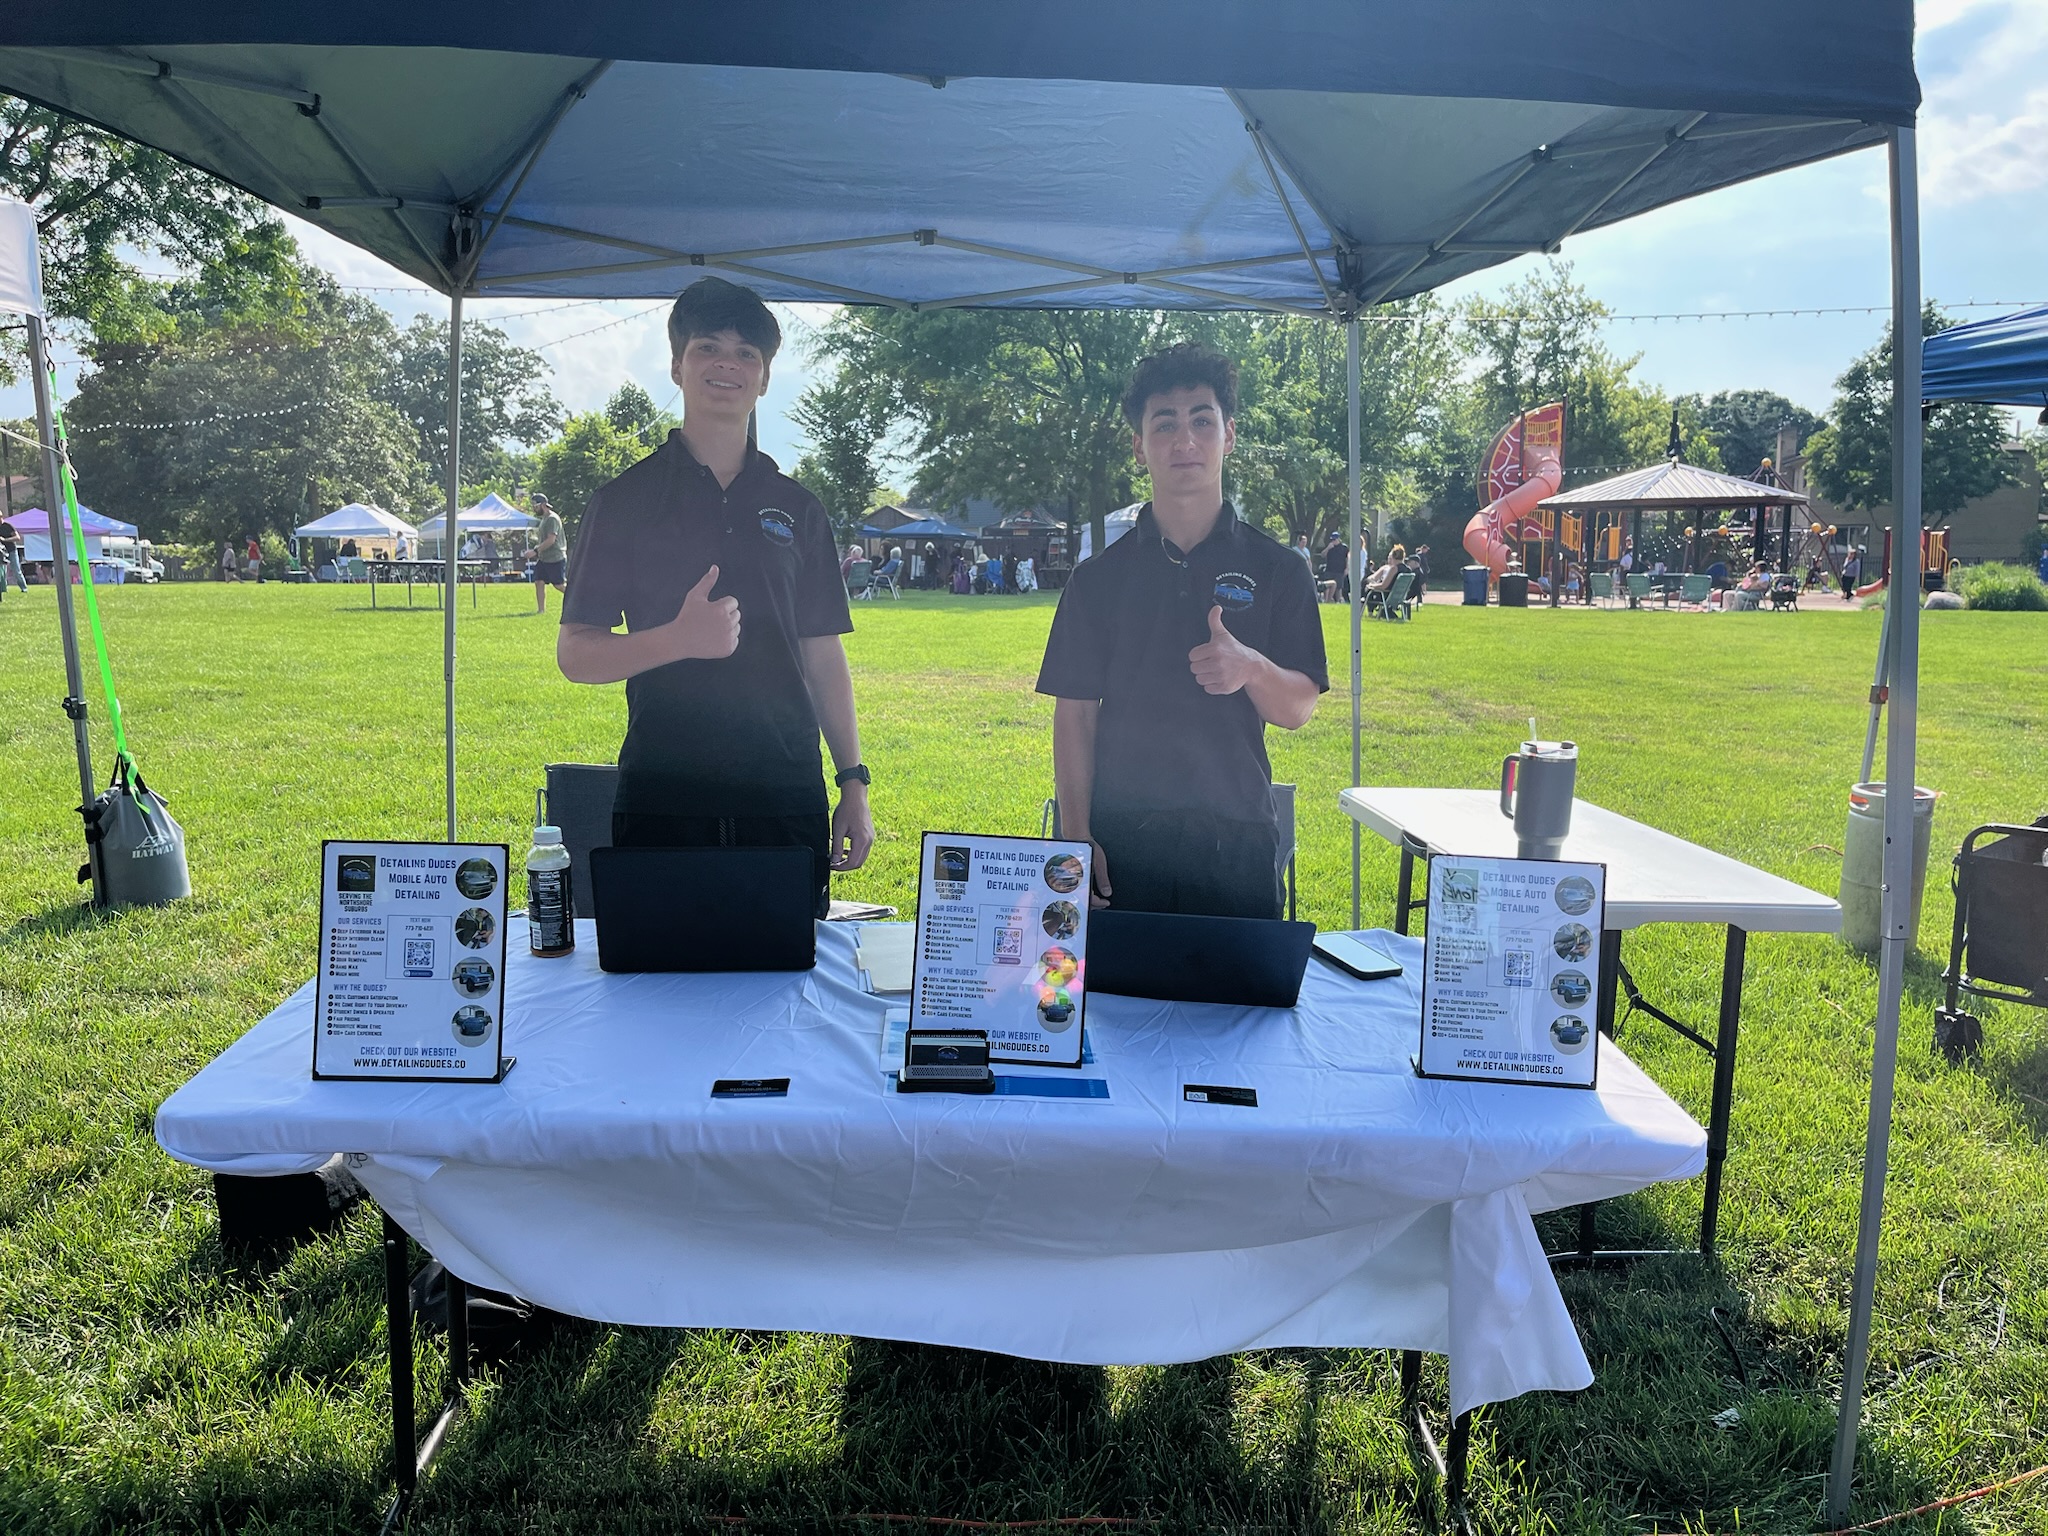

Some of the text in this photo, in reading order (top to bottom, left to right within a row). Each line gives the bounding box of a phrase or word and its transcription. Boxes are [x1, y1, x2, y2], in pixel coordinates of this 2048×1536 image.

[1216, 572, 1242, 581] DETAILING
[132, 843, 174, 858] HATWAY
[974, 850, 1017, 862] DETAILING
[1018, 852, 1045, 863] DUDES
[381, 858, 426, 868] DETAILING
[428, 859, 457, 869] DUDES
[981, 865, 1036, 877] MOBILE AUTO
[389, 874, 448, 884] MOBILE AUTO
[1483, 872, 1556, 886] DETAILING DUDES
[987, 880, 1029, 891] DETAILING
[395, 889, 440, 900] DETAILING
[1490, 887, 1547, 900] MOBILE AUTO
[946, 906, 974, 914] SERVICES
[1496, 902, 1539, 914] DETAILING
[955, 968, 977, 976] DUDES?
[1466, 990, 1488, 998] DUDES?
[992, 1030, 1041, 1041] OUR WEBSITE!
[360, 1046, 457, 1056] CHECK OUT OUR WEBSITE!
[991, 1041, 1049, 1053] ILINGDUDES.CO
[1463, 1049, 1555, 1063] CHECK OUT OUR WEBSITE!
[354, 1059, 466, 1069] WWW.DETAILINGDUDES.CO
[1457, 1060, 1564, 1075] WWW.DETAILINGDUDES.CO
